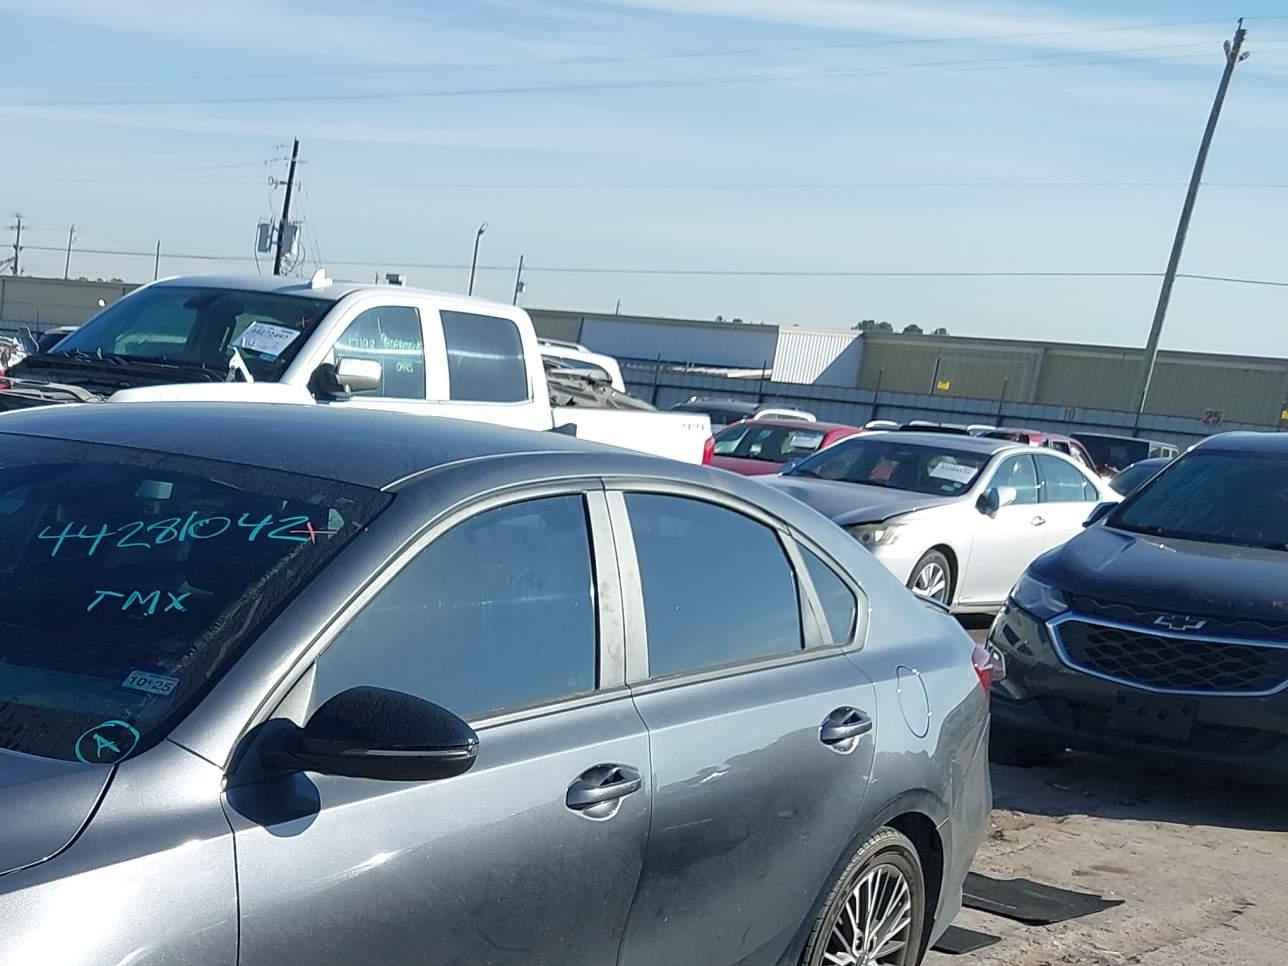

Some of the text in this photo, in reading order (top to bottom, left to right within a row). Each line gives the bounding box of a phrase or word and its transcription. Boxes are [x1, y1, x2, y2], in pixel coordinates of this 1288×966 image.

[1203, 410, 1222, 424] 25
[37, 511, 312, 557] 44281042
[87, 590, 192, 616] TMX
[130, 675, 173, 692] 10 25
[92, 733, 121, 758] A
